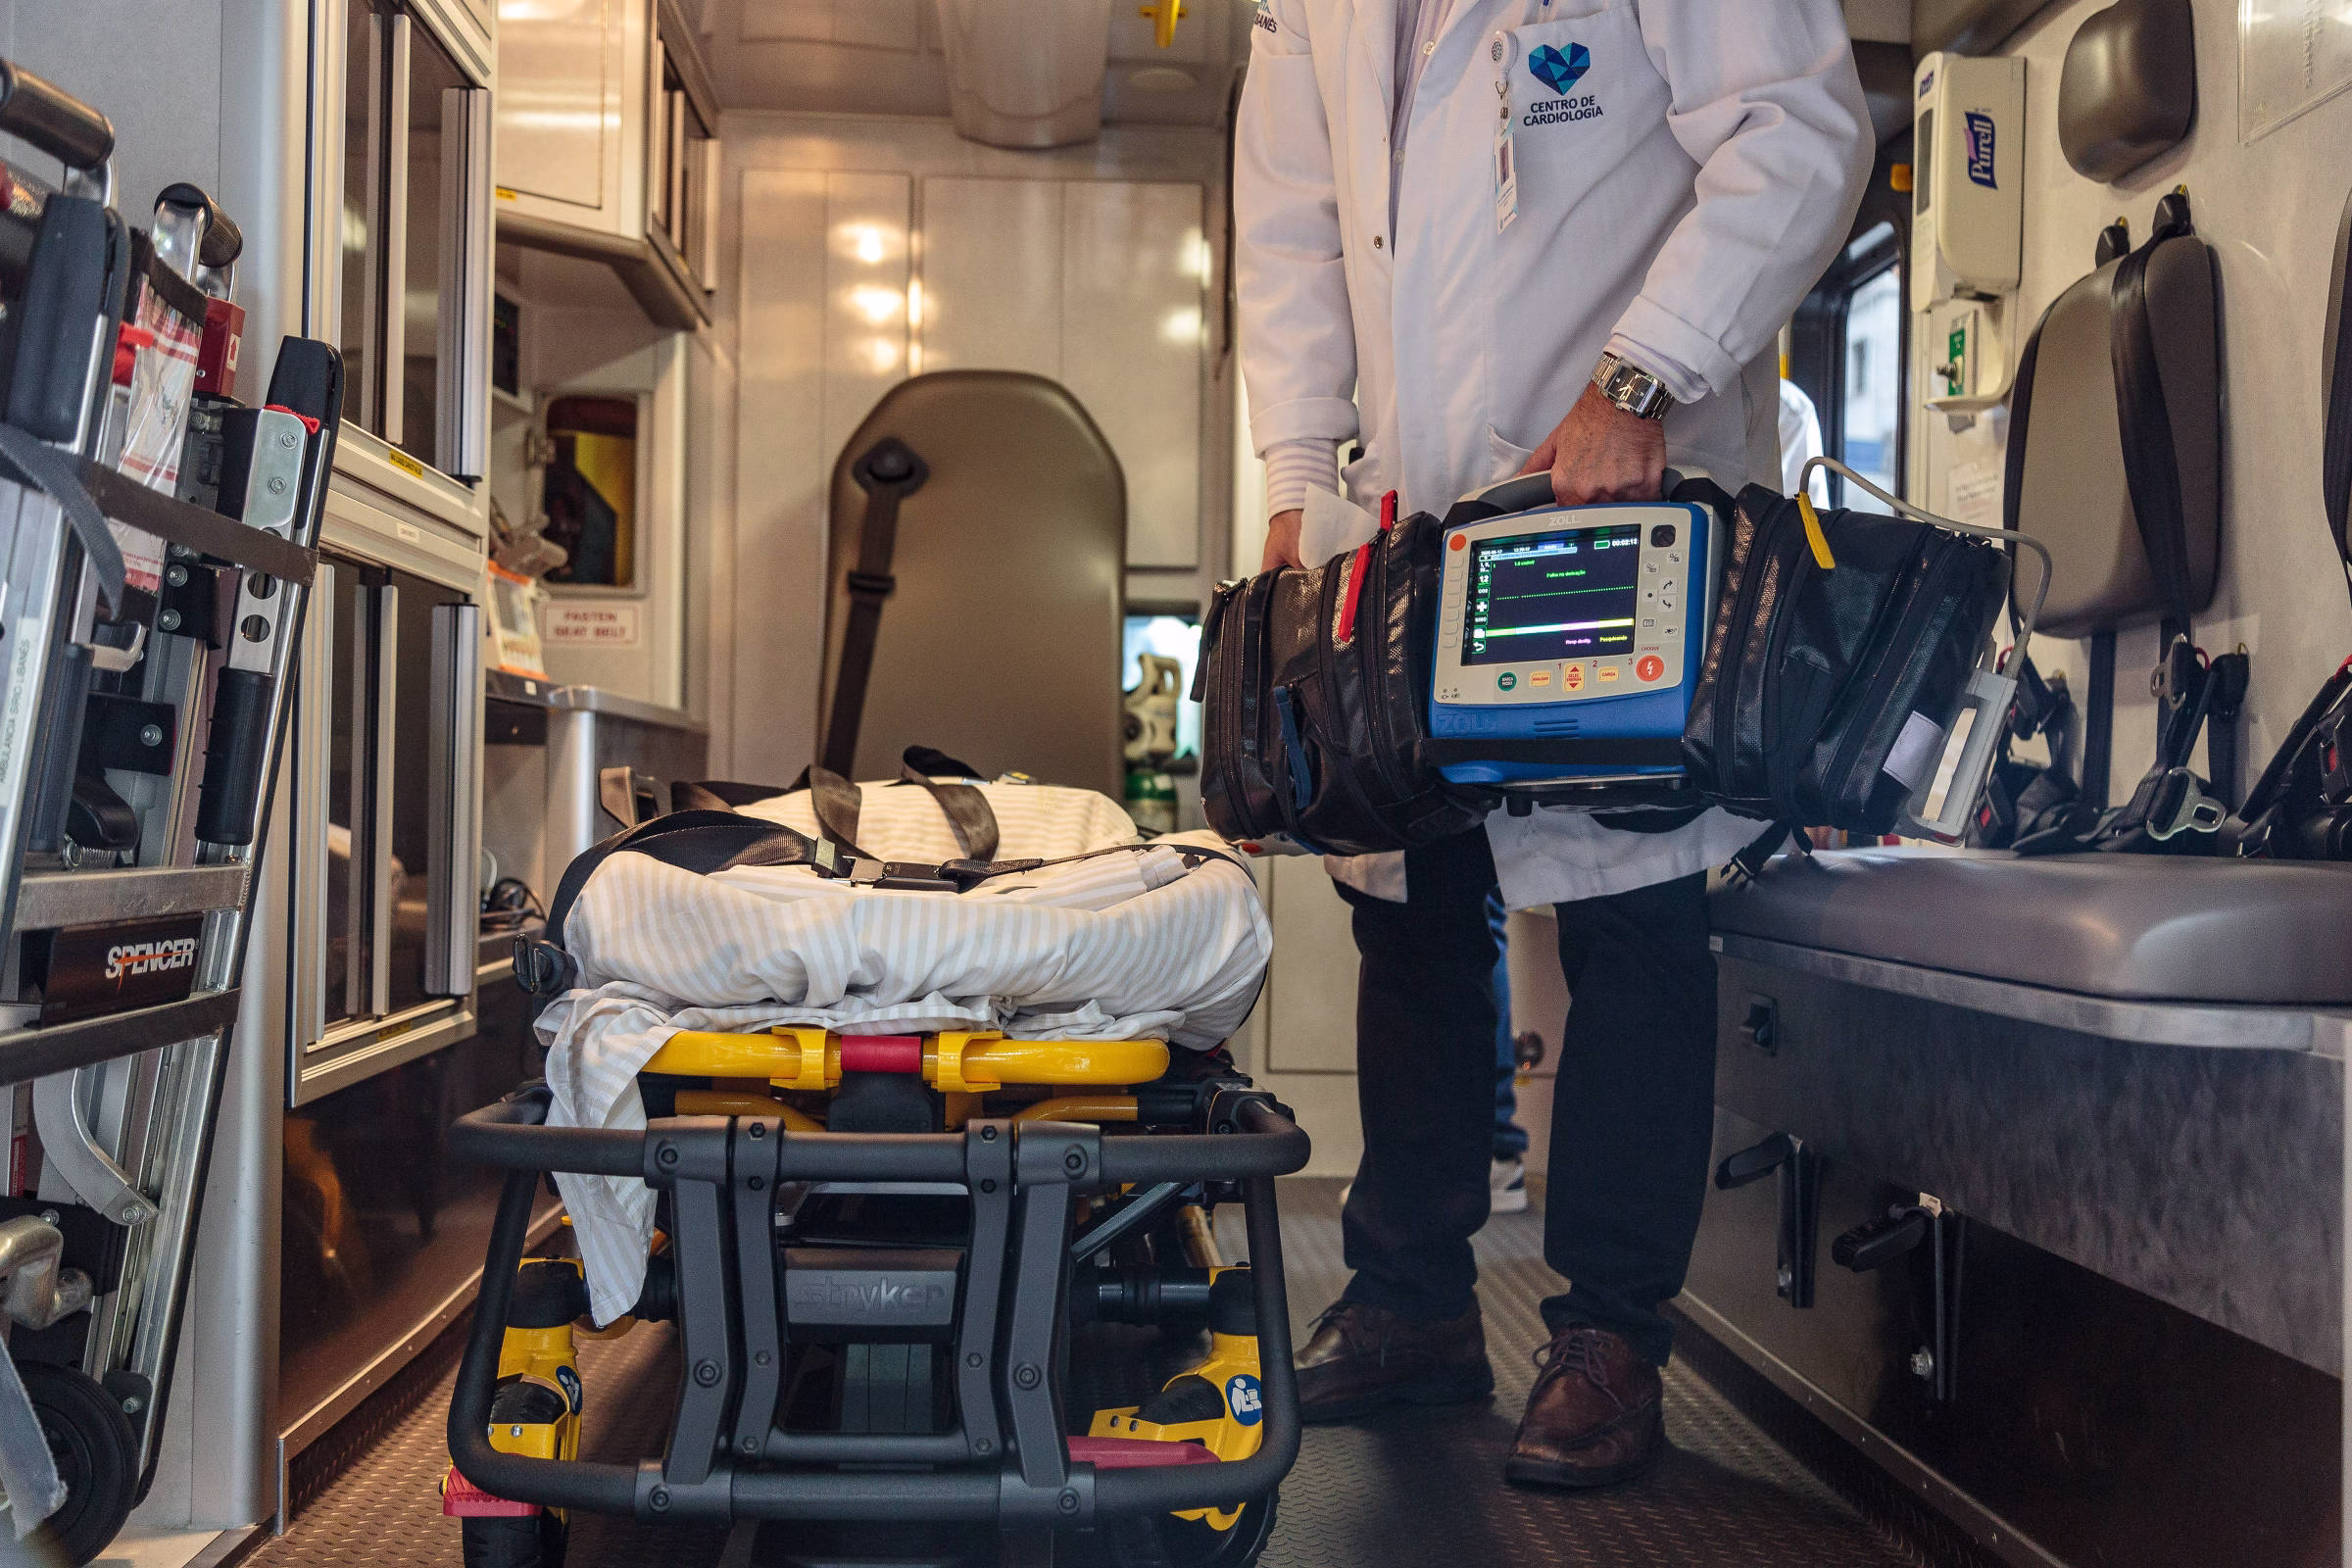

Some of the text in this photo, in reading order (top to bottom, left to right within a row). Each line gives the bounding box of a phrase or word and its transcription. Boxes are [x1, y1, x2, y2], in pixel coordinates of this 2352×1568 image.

[1530, 95, 1595, 114] CENTRO DE
[1523, 106, 1603, 126] CARDIOLOGIA
[1972, 119, 1991, 180] Purell
[1548, 515, 1581, 526] ZOLL
[1479, 574, 1489, 583] 12
[1436, 711, 1496, 734] ZOLL
[105, 938, 196, 980] SPENCER
[793, 1276, 947, 1311] stryker
